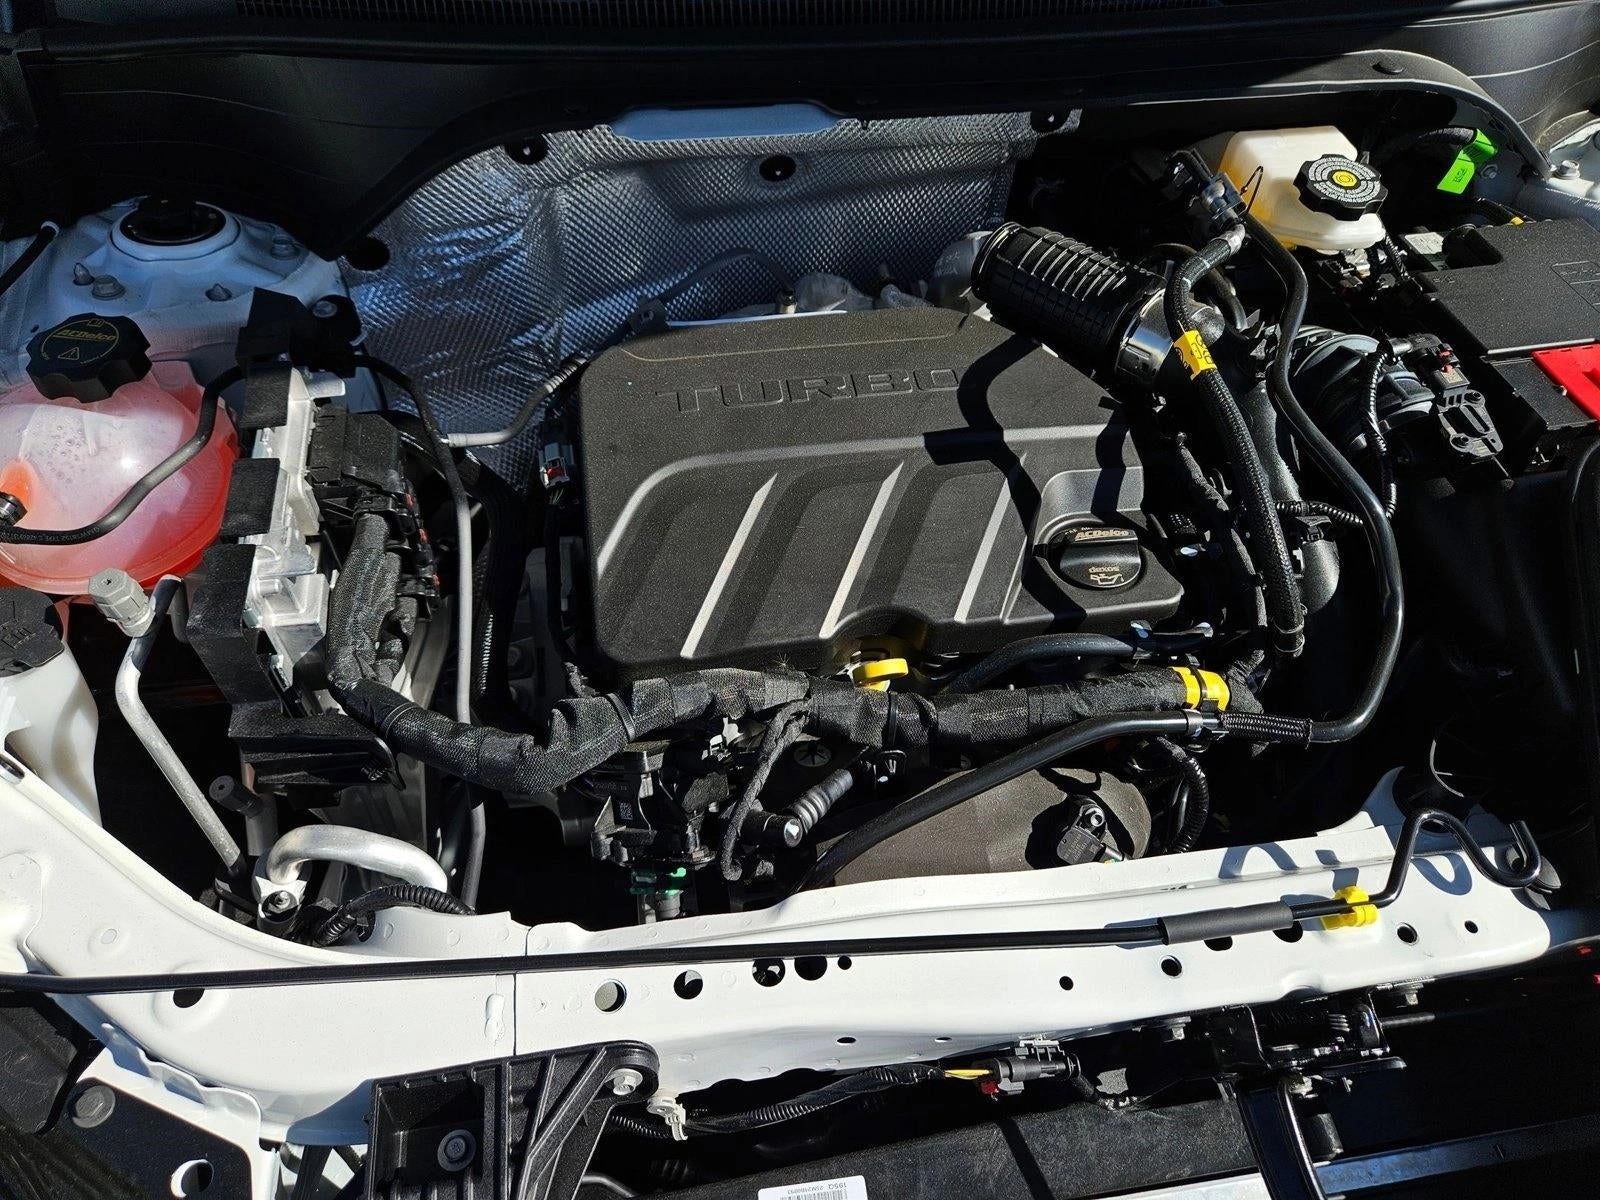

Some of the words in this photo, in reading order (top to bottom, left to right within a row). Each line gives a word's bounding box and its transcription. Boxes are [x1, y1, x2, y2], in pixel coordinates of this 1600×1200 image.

[57, 329, 116, 341] ACDelco
[655, 367, 970, 412] TURBO
[1075, 529, 1129, 540] ACDelco
